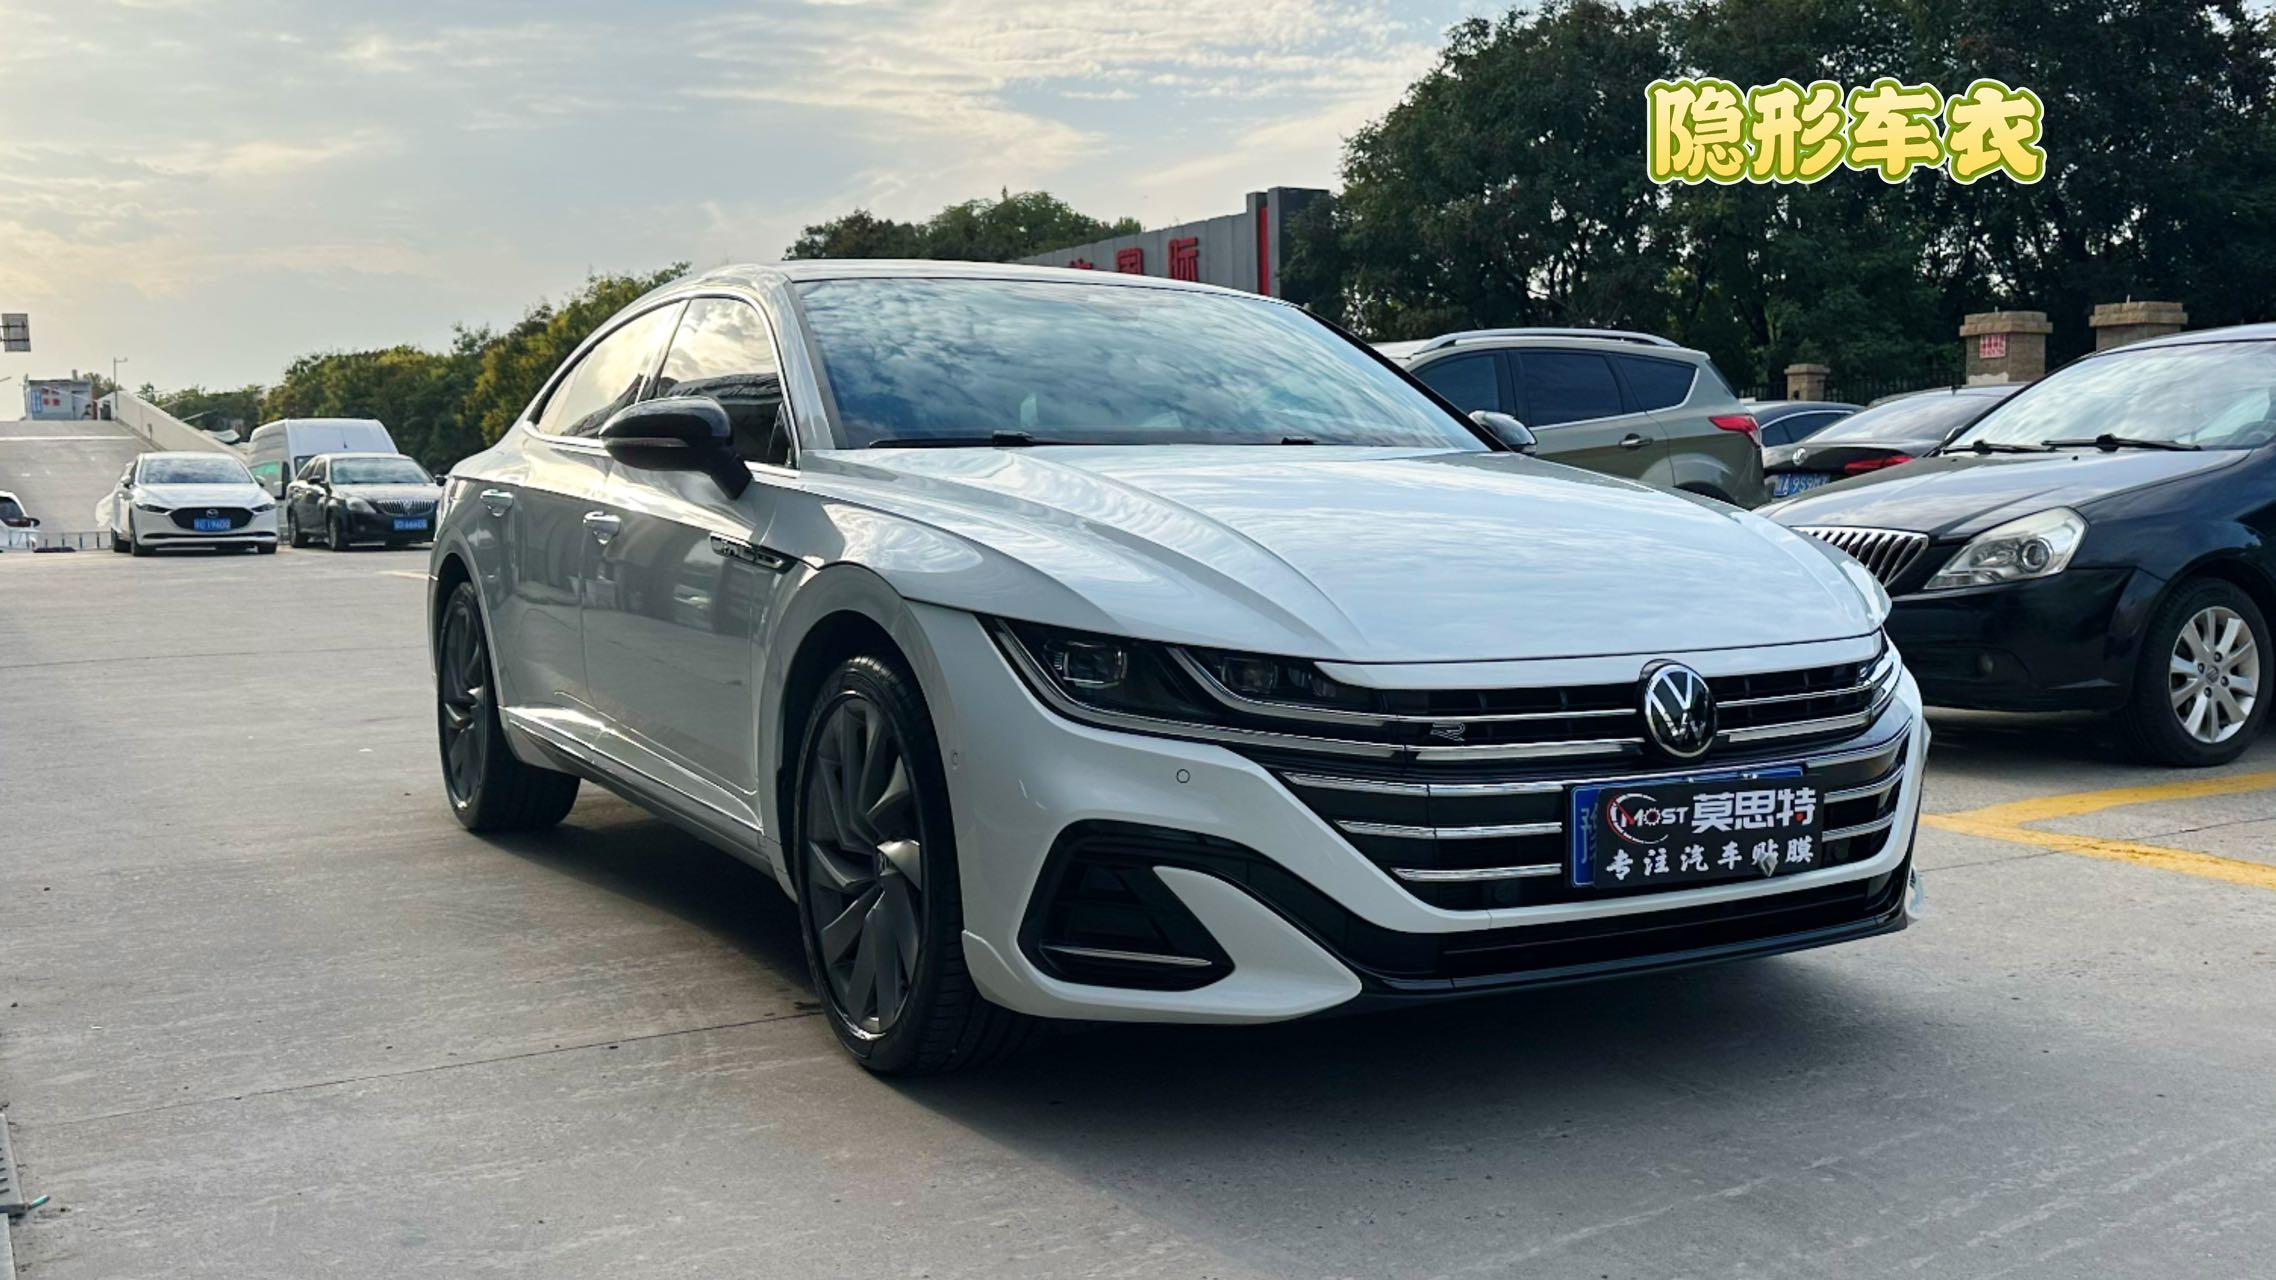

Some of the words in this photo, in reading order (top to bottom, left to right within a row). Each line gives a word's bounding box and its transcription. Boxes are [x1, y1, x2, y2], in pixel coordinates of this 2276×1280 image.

[1691, 787, 1817, 834] 莫思特
[1606, 835, 1814, 881] 专注汽车贴膜
